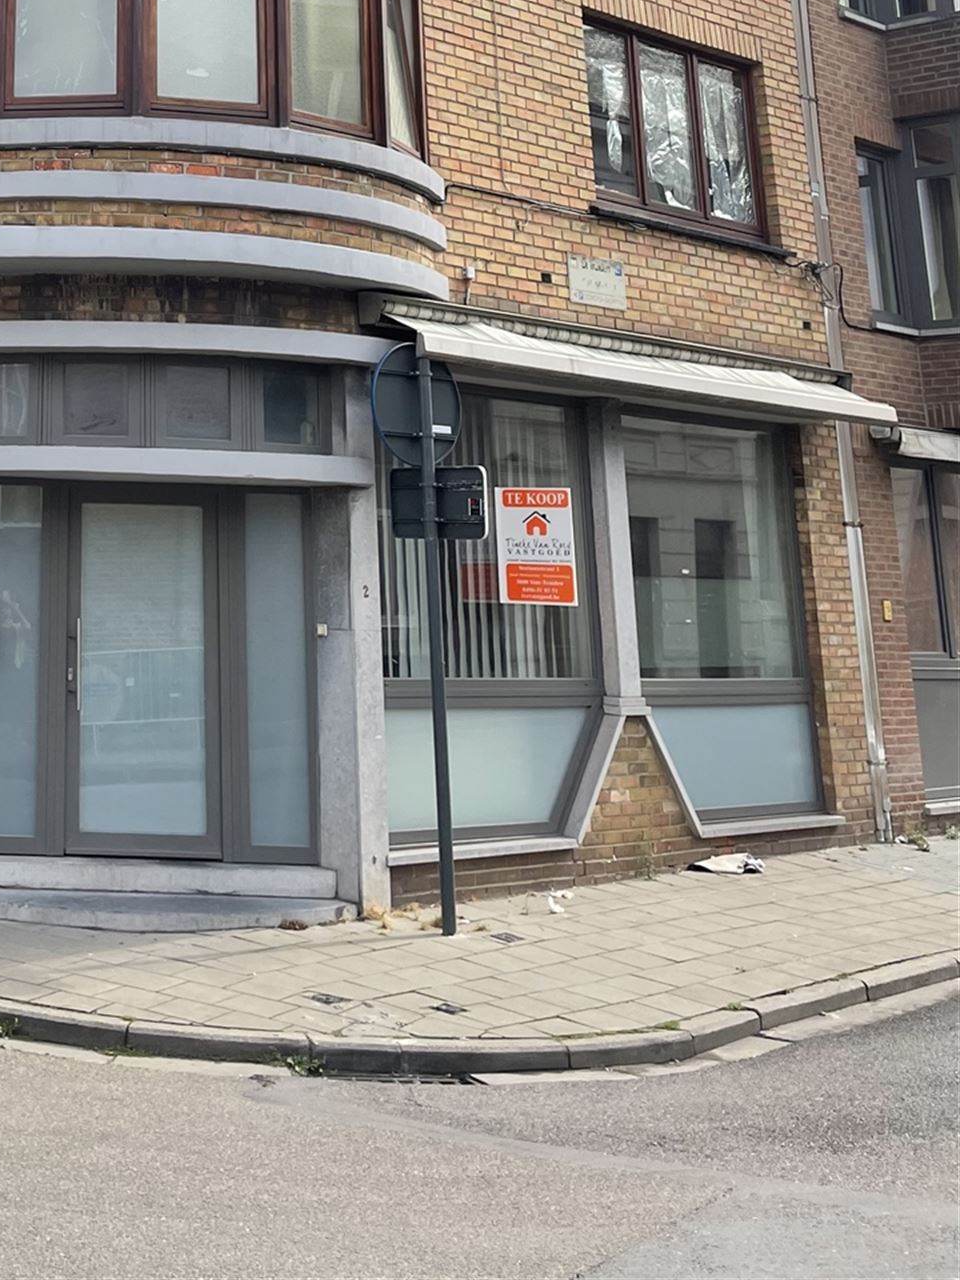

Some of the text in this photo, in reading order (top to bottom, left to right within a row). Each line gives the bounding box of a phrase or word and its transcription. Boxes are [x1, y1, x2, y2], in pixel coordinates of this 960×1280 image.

[504, 492, 566, 505] TE KOOP
[506, 548, 571, 556] VASTGOED
[362, 584, 369, 598] 2
